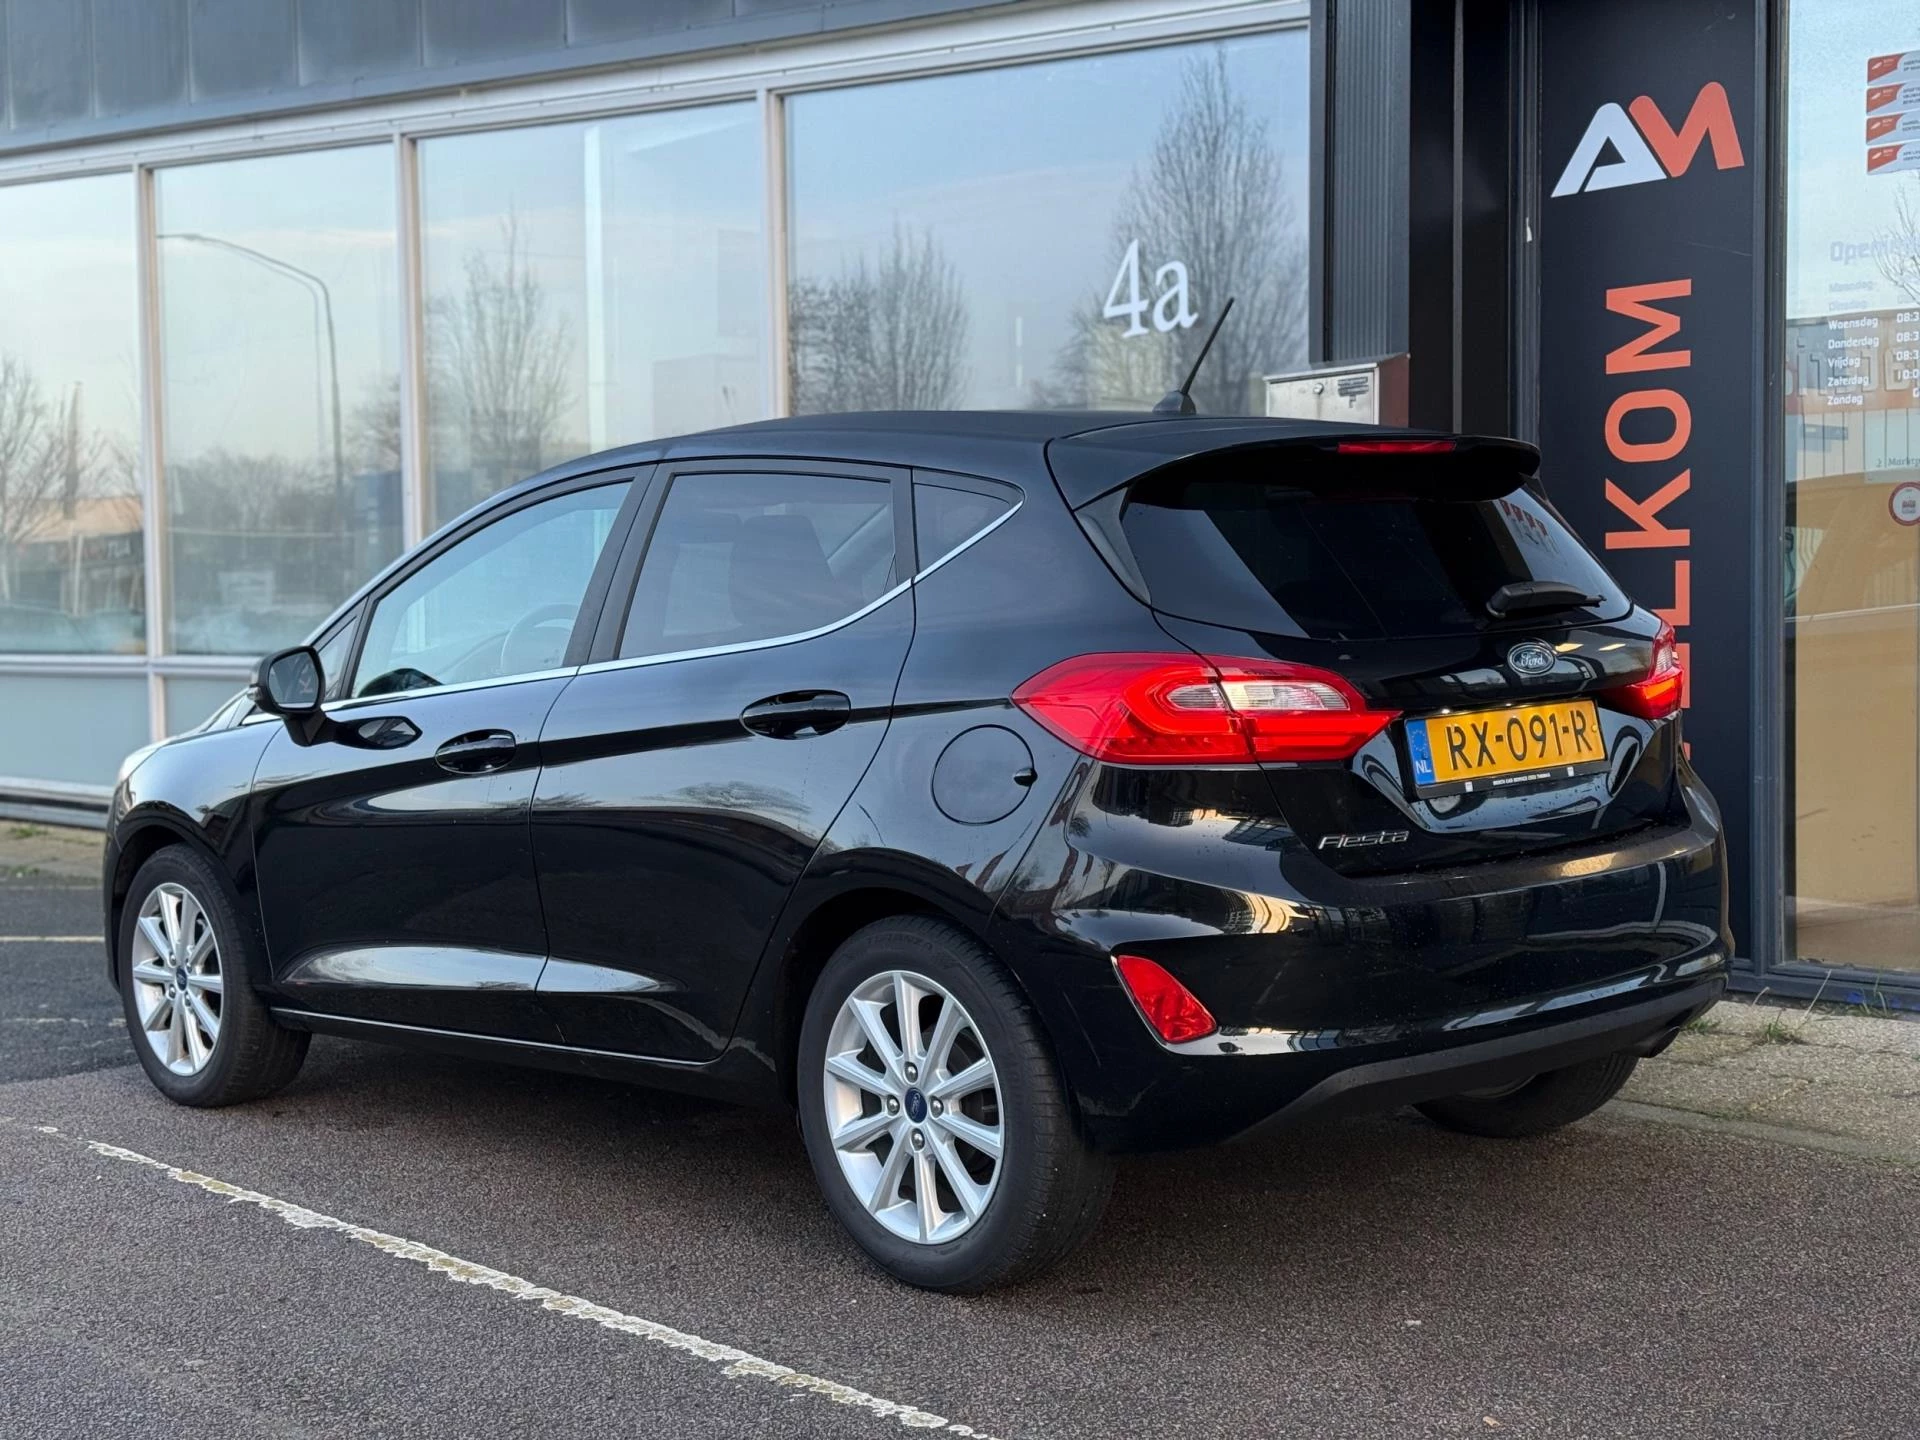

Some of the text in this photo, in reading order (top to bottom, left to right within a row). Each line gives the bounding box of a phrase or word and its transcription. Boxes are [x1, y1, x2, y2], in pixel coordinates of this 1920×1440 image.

[1551, 81, 1745, 198] AM
[1103, 238, 1199, 338] 4a
[1828, 316, 1879, 330] Woensdag
[1828, 335, 1880, 349] Donderdag
[1827, 356, 1861, 369] Vrijdag
[1827, 374, 1870, 387] Zaterdag
[1827, 394, 1864, 406] Zondag
[1604, 279, 1691, 761] LKOM
[1446, 710, 1592, 771] RX-091-R
[1415, 759, 1433, 775] NL
[1318, 830, 1410, 850] Fiesta
